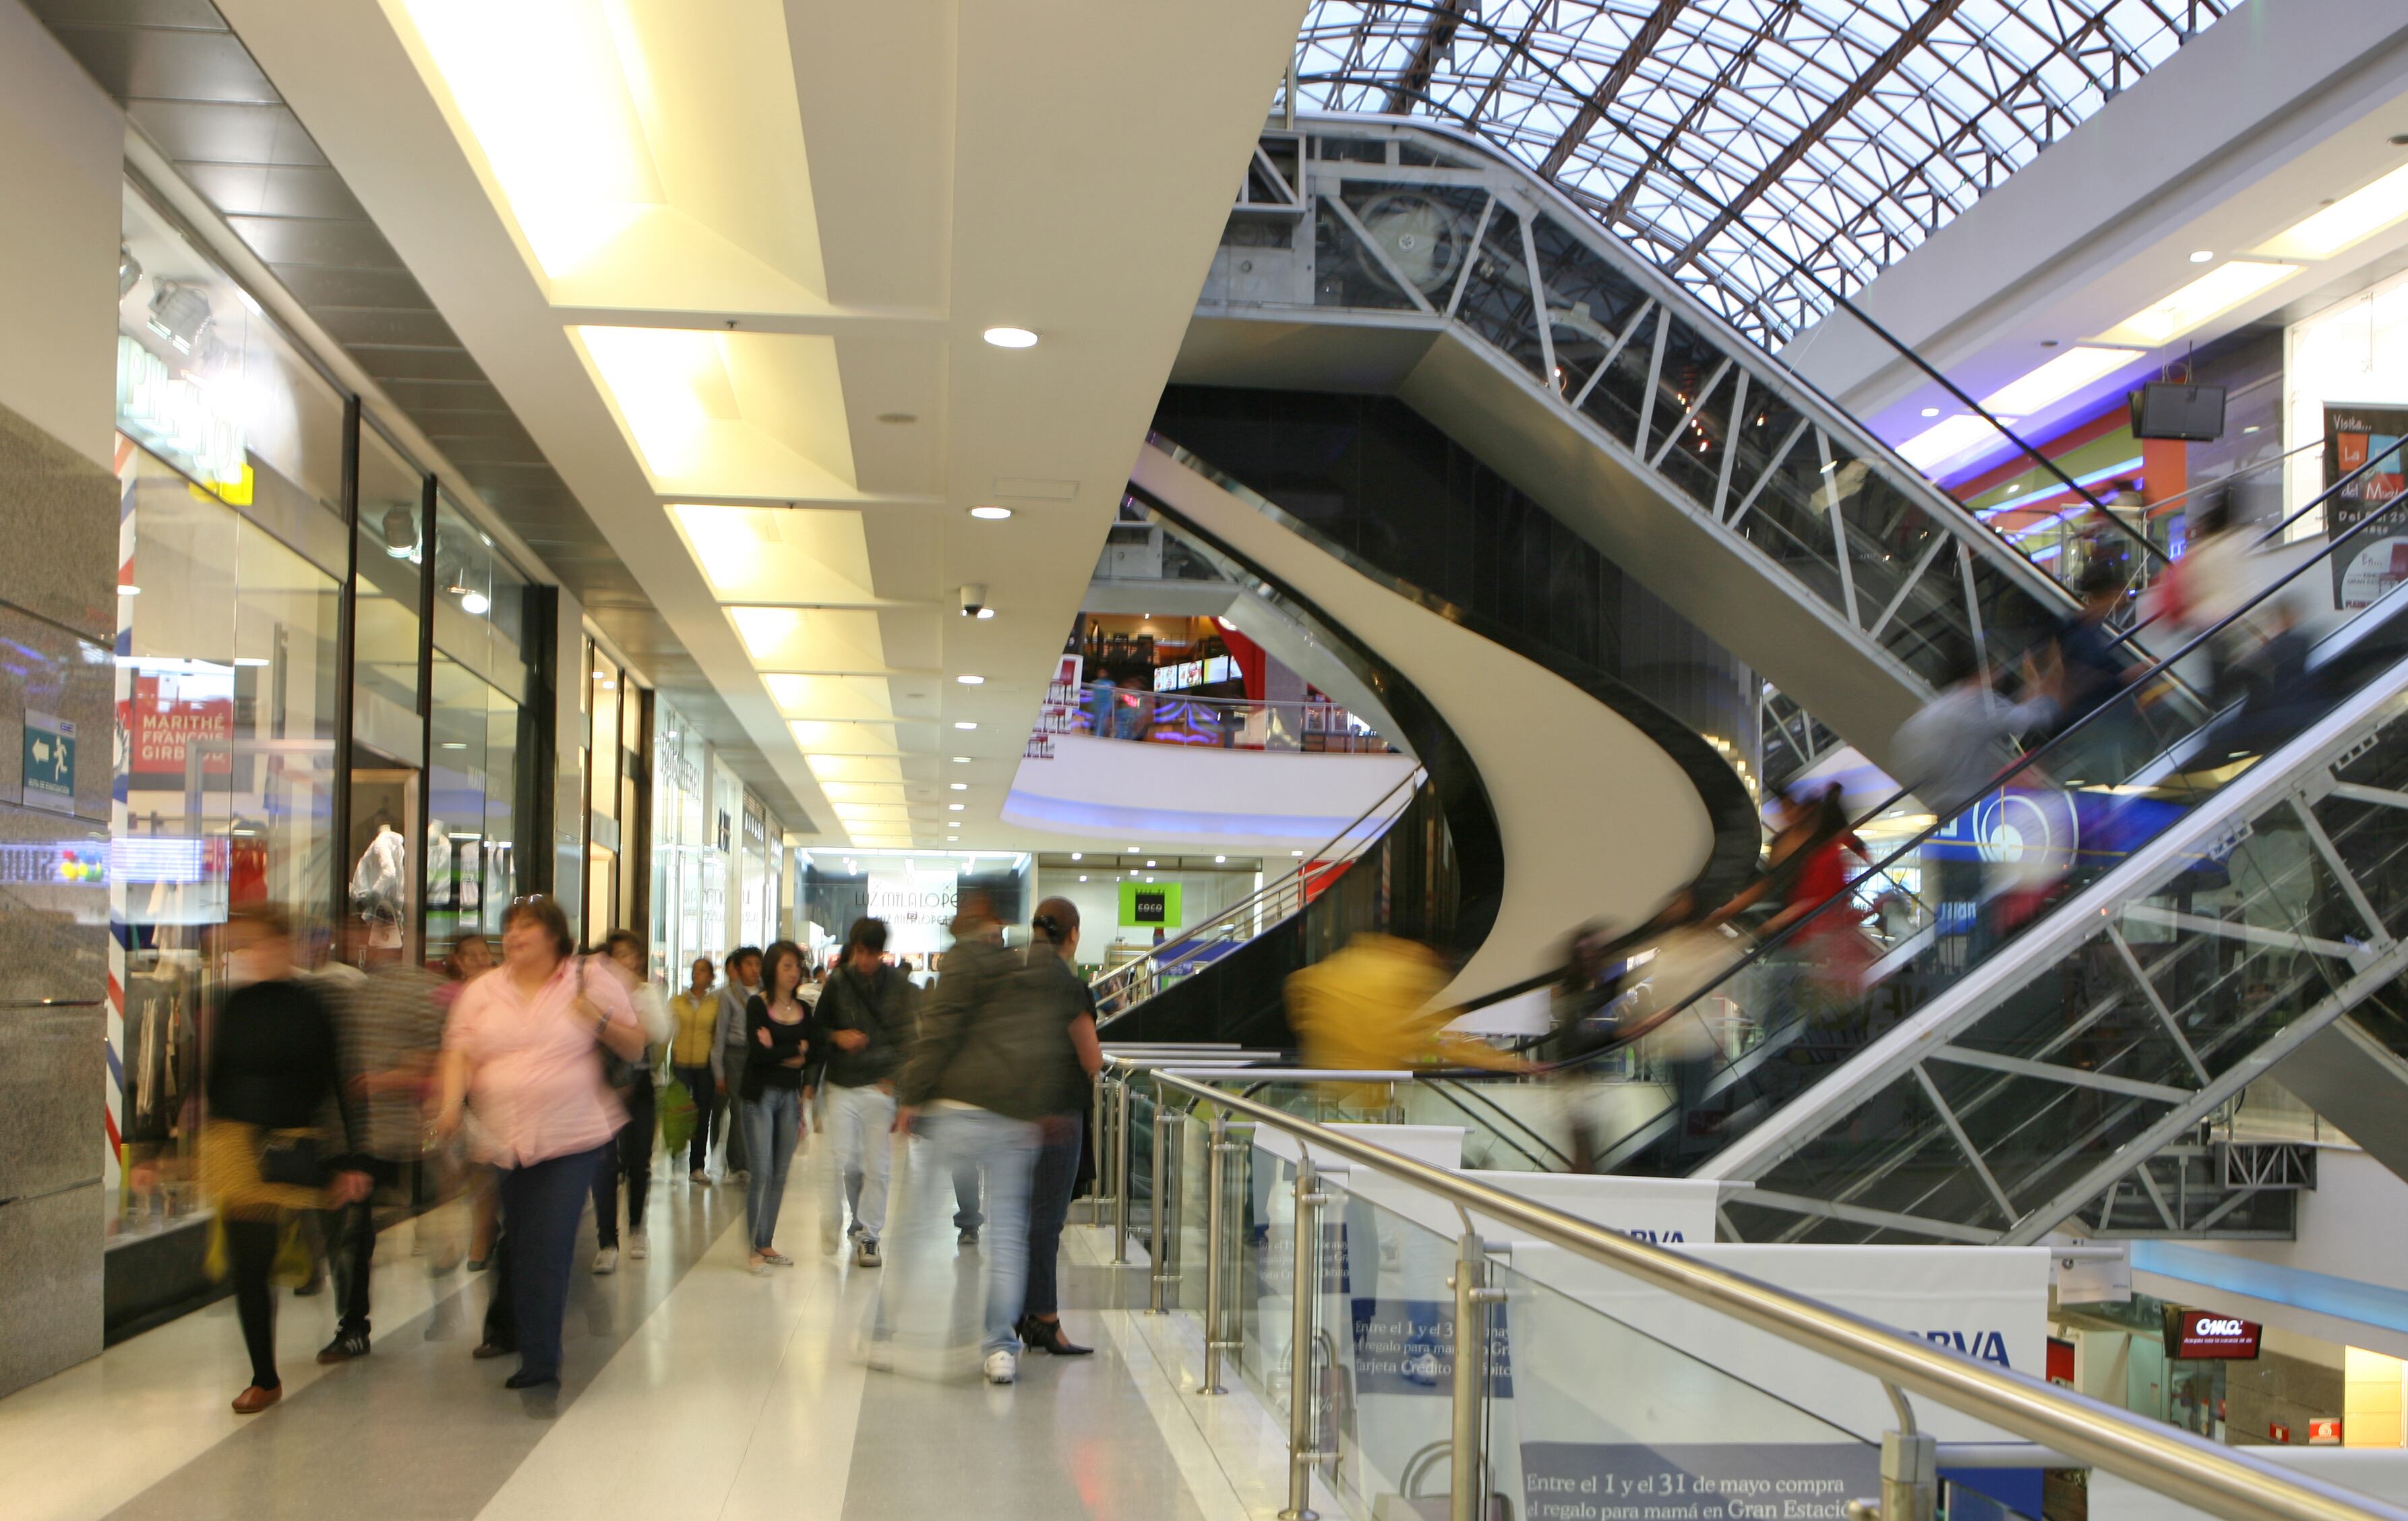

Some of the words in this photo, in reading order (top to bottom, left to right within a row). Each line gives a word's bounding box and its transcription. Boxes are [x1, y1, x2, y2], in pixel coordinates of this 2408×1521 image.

[2345, 446, 2359, 461] La
[143, 713, 224, 730] MARITHÉ
[1356, 1320, 1386, 1333] Entre
[1390, 1321, 1401, 1334] el
[1407, 1321, 1414, 1334] 1
[1418, 1325, 1426, 1338] y
[1429, 1323, 1440, 1335] el
[1365, 1340, 1401, 1353] regalo
[1404, 1344, 1430, 1355] para
[1356, 1358, 1396, 1375] Tarjeta
[1528, 1473, 1575, 1493] Entre
[1581, 1476, 1596, 1494] el
[1605, 1473, 1615, 1494] 1
[1621, 1479, 1634, 1498] y
[1637, 1476, 1654, 1494] el
[1658, 1473, 1685, 1496] 31
[1693, 1476, 1715, 1493] de
[1720, 1479, 1770, 1497] mayo
[1776, 1479, 1844, 1497] compra
[1528, 1501, 1538, 1516] el
[1543, 1502, 1596, 1520] regalo
[1602, 1505, 1639, 1521] para
[1645, 1503, 1698, 1518] mamá
[1703, 1505, 1722, 1518] en
[1728, 1499, 1778, 1518] Gran
